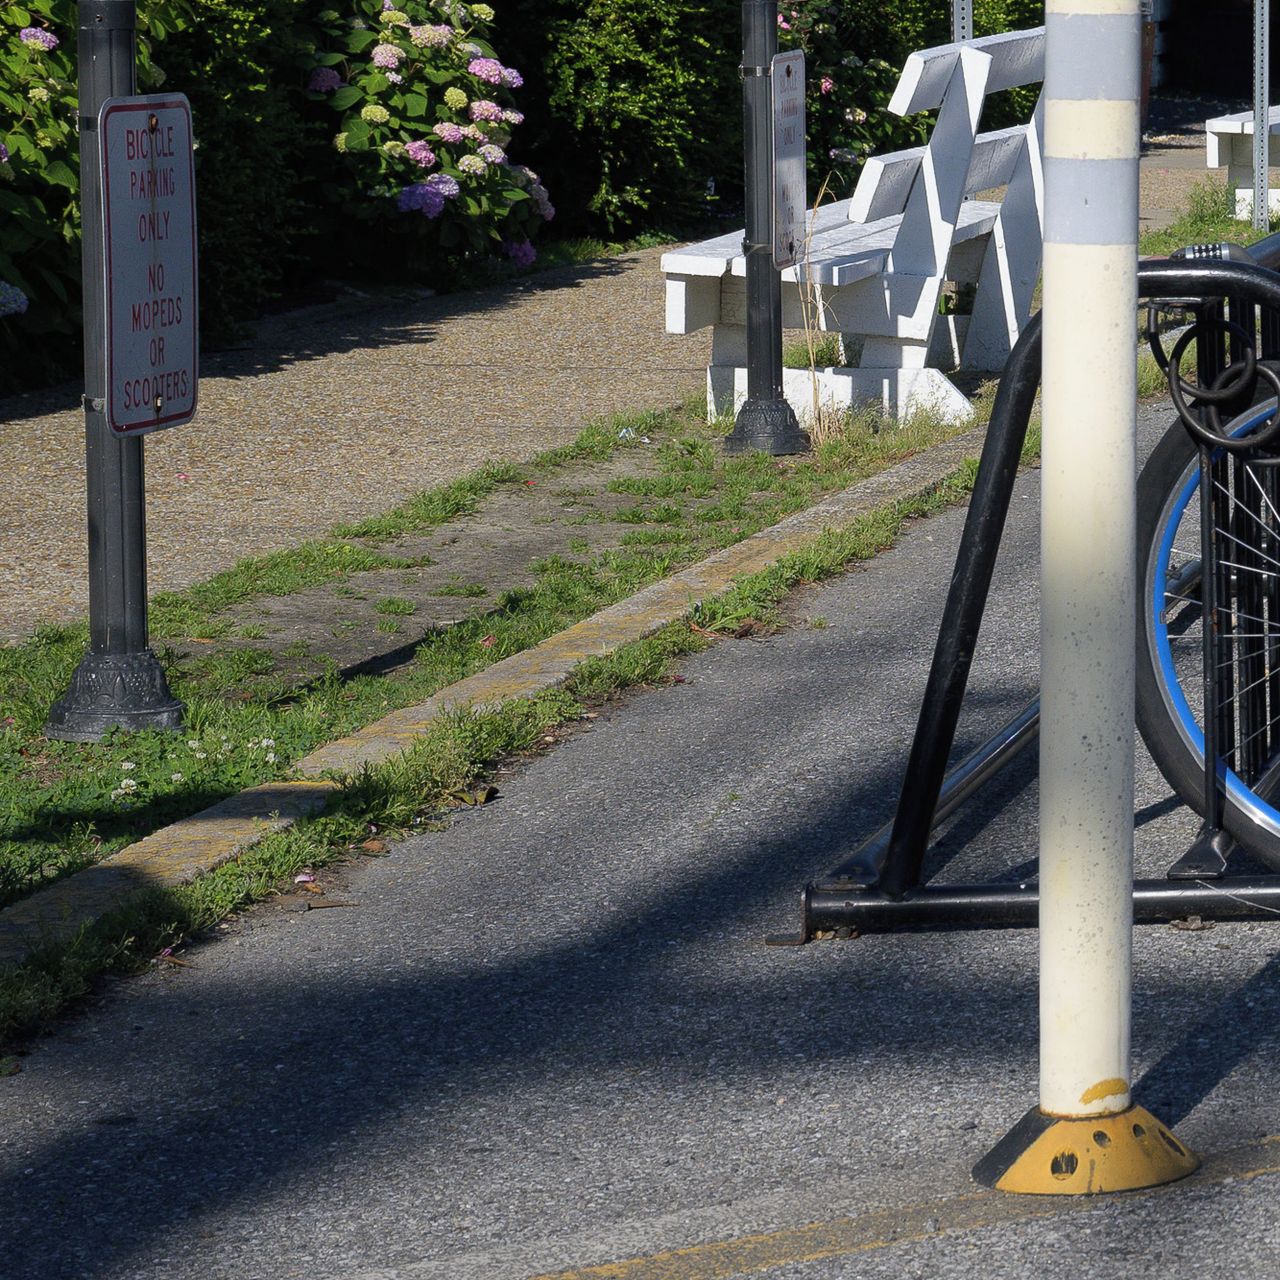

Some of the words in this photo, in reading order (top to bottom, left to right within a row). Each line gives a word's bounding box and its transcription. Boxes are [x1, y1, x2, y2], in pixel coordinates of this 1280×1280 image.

[125, 125, 175, 162] BICYCLE
[129, 167, 175, 201] PARKING
[138, 211, 170, 243] ONLY
[148, 263, 165, 294] NO
[131, 296, 182, 333] MOPEDS
[150, 336, 165, 367] OR
[123, 369, 188, 411] SCOOTERS
